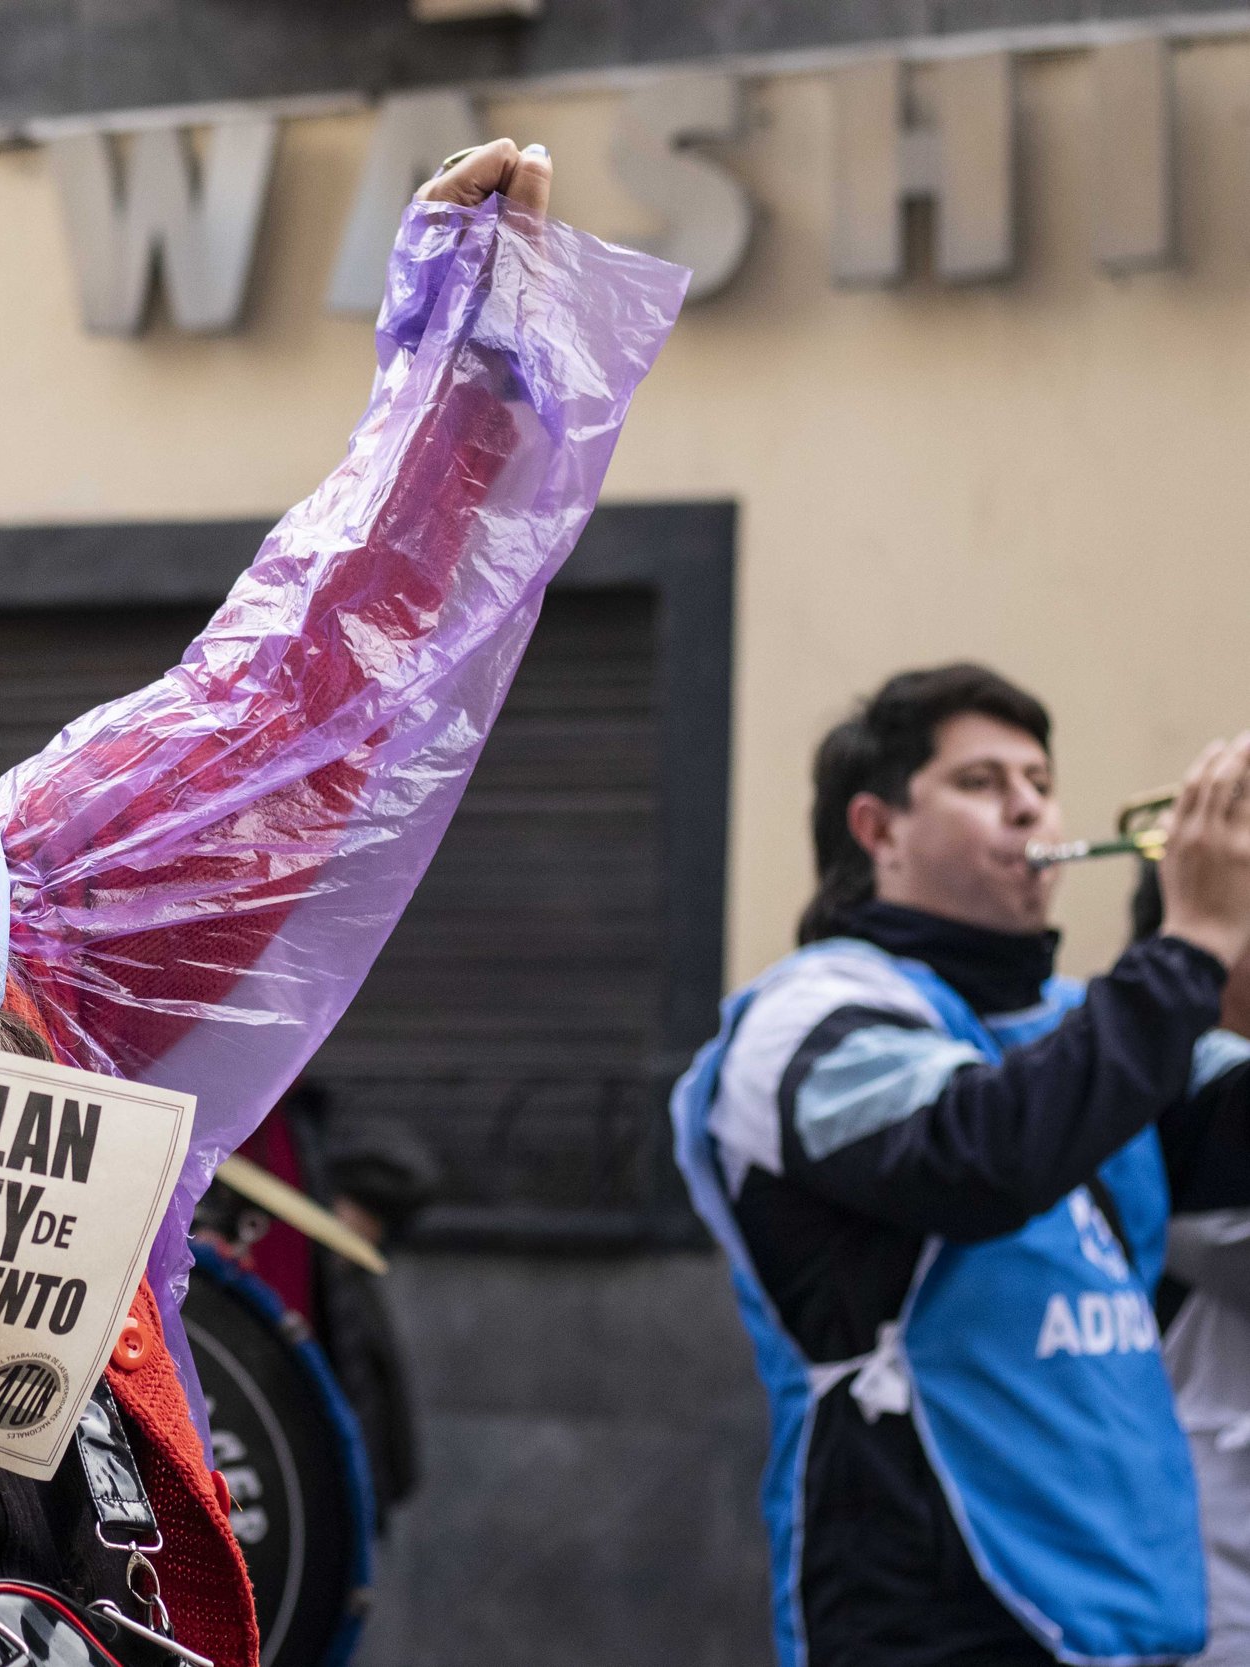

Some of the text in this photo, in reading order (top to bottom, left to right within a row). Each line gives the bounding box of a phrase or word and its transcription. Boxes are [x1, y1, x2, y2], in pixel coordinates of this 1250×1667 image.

[31, 1210, 77, 1250] DE
[6, 1351, 52, 1361] TRABAJADOR
[51, 1357, 59, 1365] DE
[7, 1421, 52, 1439] NACIONALES
